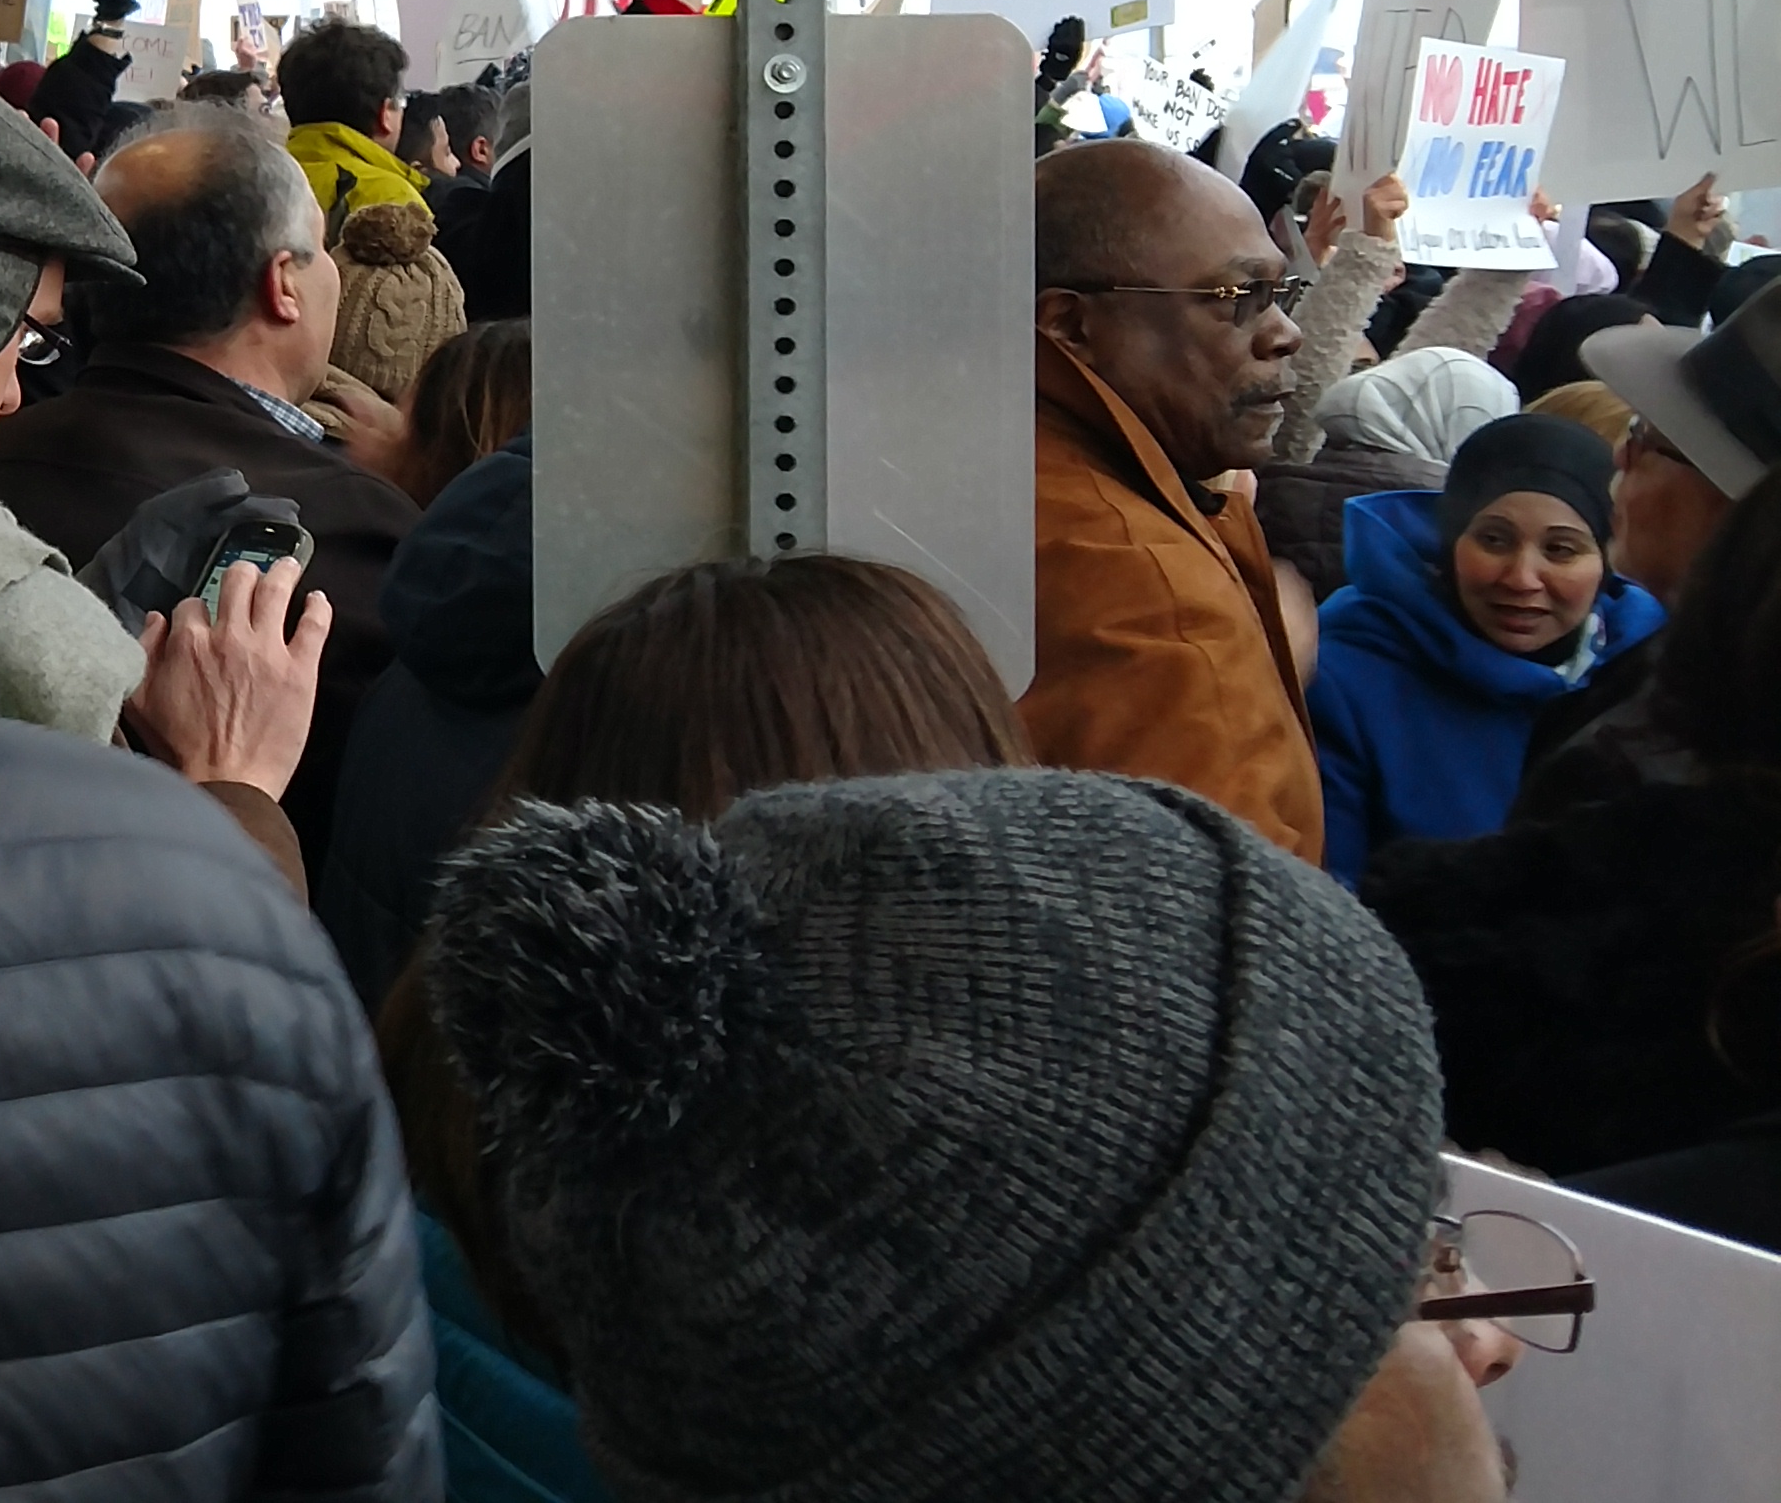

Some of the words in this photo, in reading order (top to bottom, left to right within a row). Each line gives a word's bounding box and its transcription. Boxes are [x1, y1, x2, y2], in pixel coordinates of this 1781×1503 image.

[1143, 59, 1169, 88] YOUR
[1175, 79, 1202, 109] BAN
[1418, 54, 1463, 126] NO
[1467, 56, 1533, 126] HATE
[1163, 99, 1194, 126] NOT
[1166, 127, 1180, 146] US
[1416, 135, 1465, 198] NO
[1468, 141, 1536, 199] FEAR
